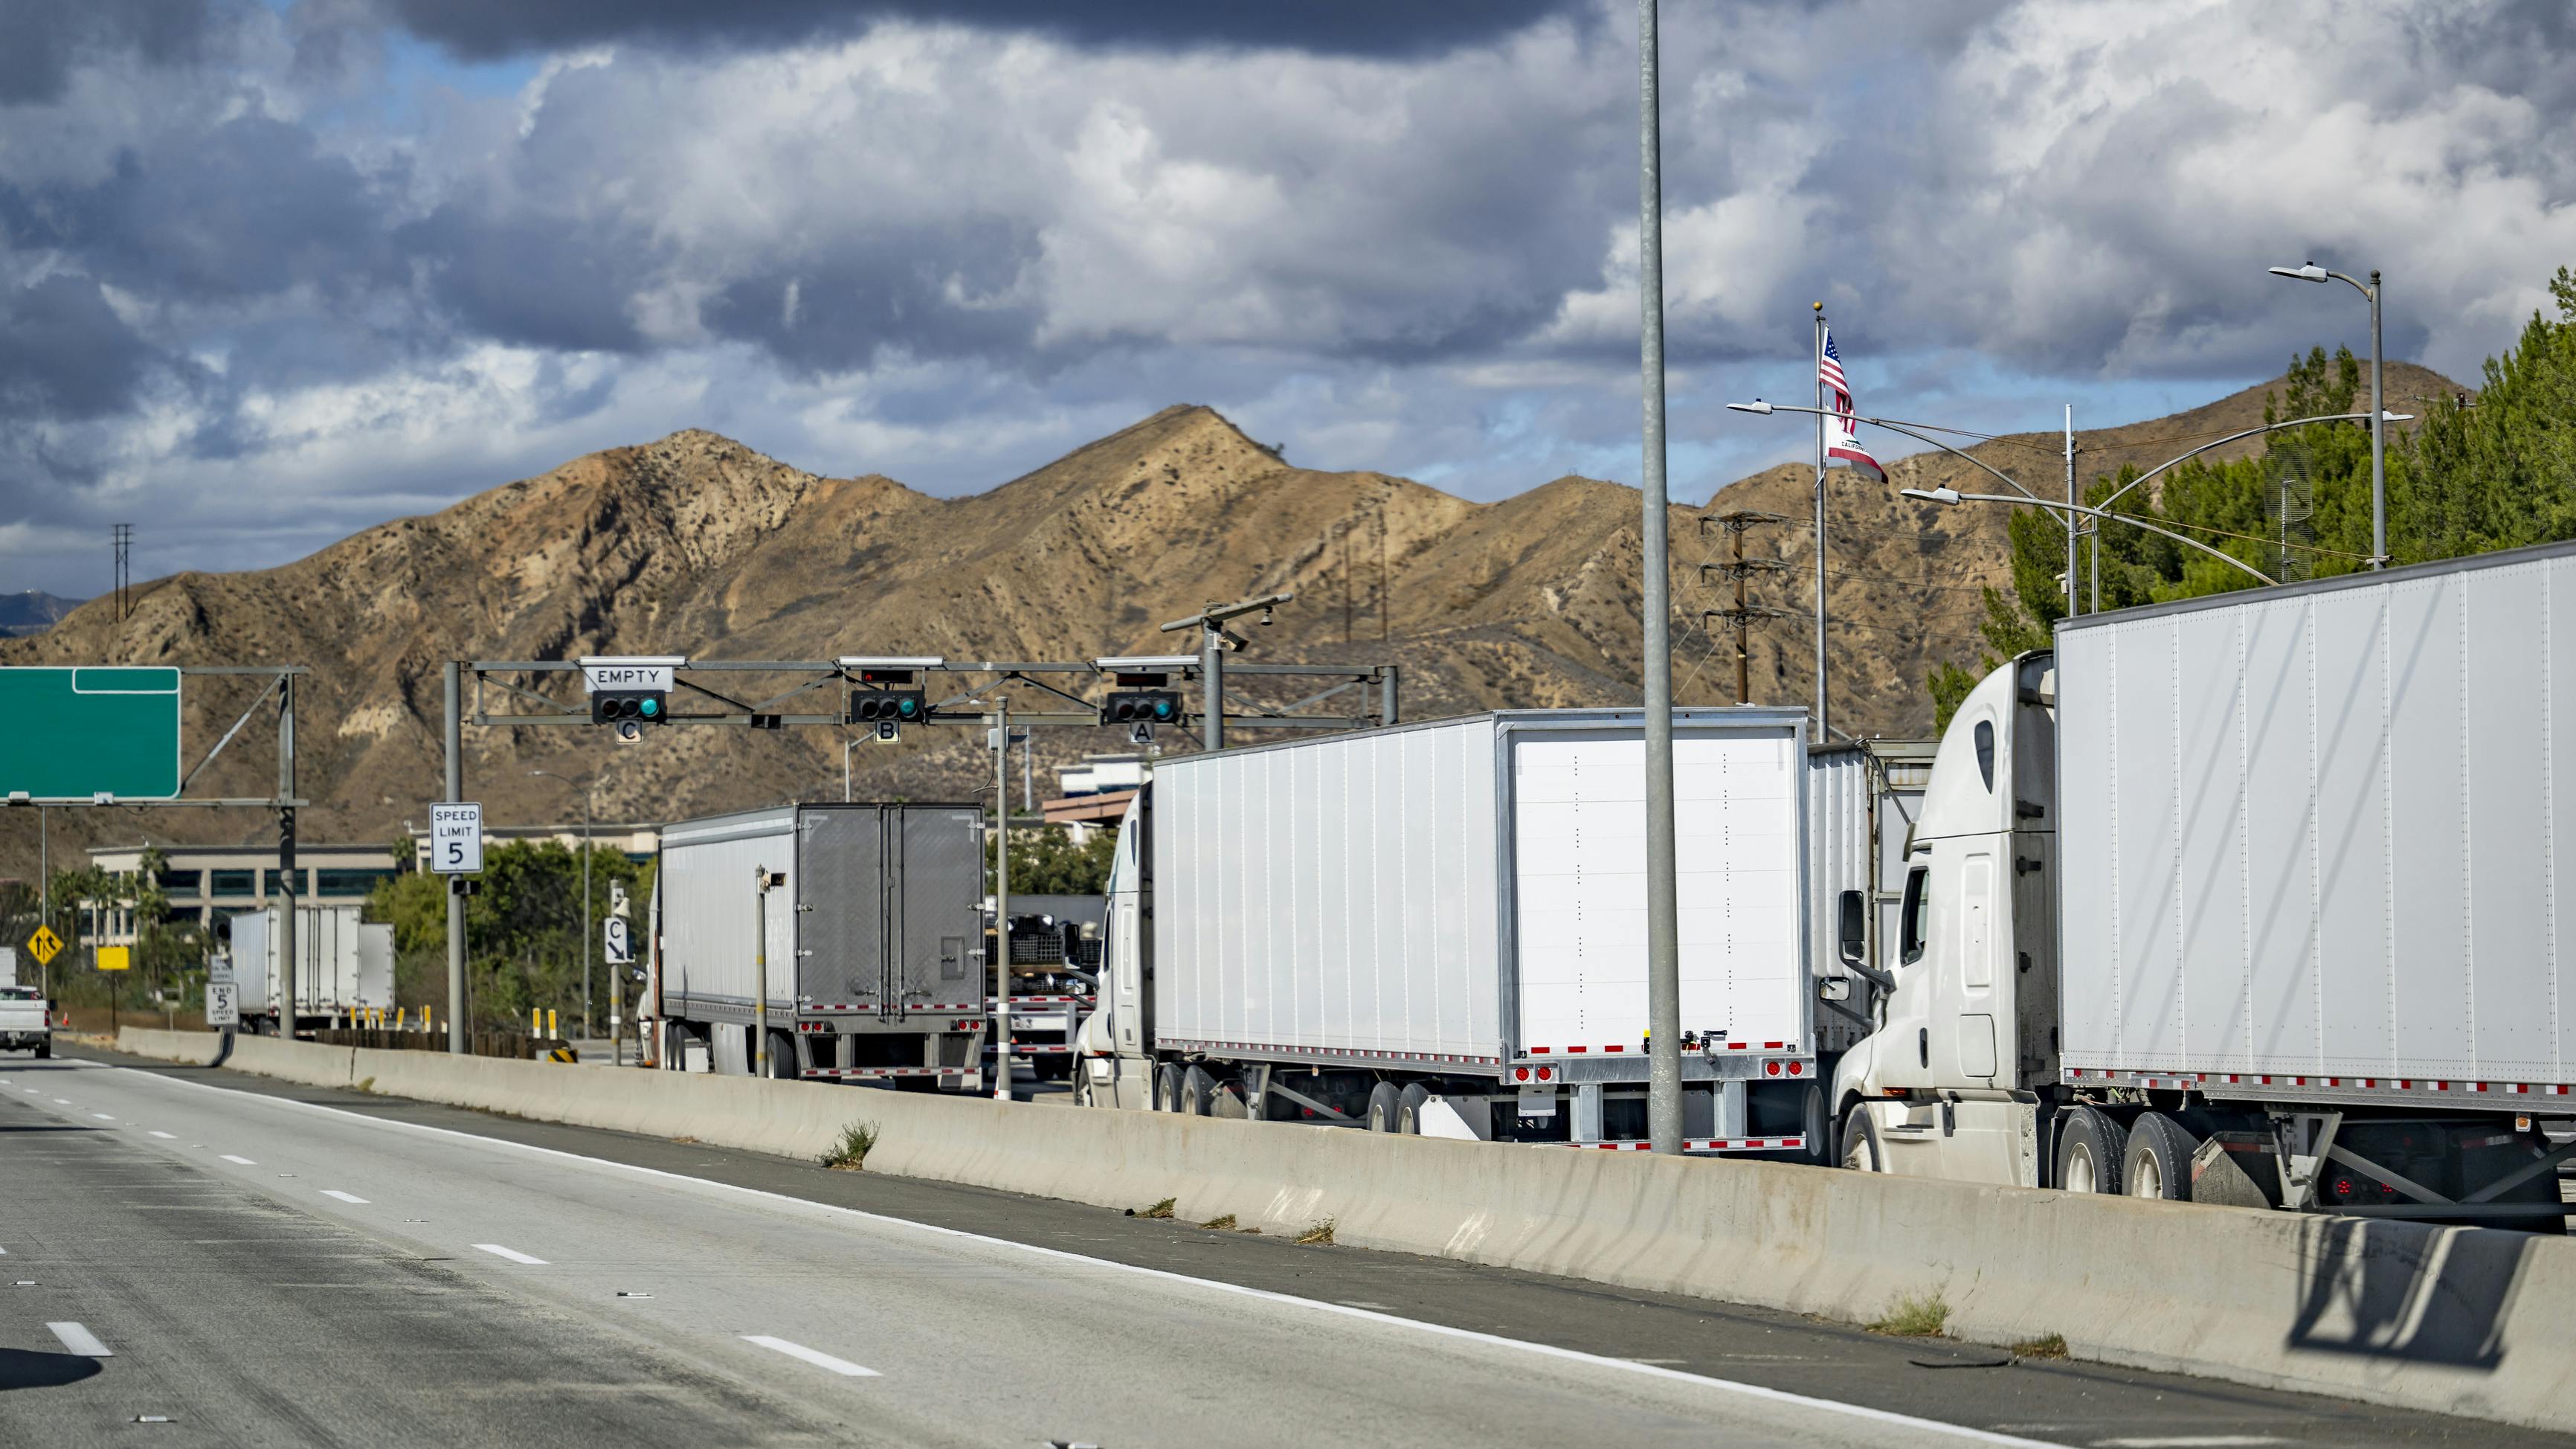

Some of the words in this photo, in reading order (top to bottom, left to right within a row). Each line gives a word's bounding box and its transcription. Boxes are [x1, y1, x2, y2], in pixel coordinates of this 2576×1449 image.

[598, 670, 660, 683] EMPTY
[622, 722, 637, 739] C
[880, 722, 895, 739] B
[1135, 723, 1151, 741] A
[435, 811, 477, 821] SPEED
[439, 826, 471, 838] LIMIT
[448, 842, 463, 864] 5
[610, 921, 621, 939] C
[218, 994, 228, 1009] 5
